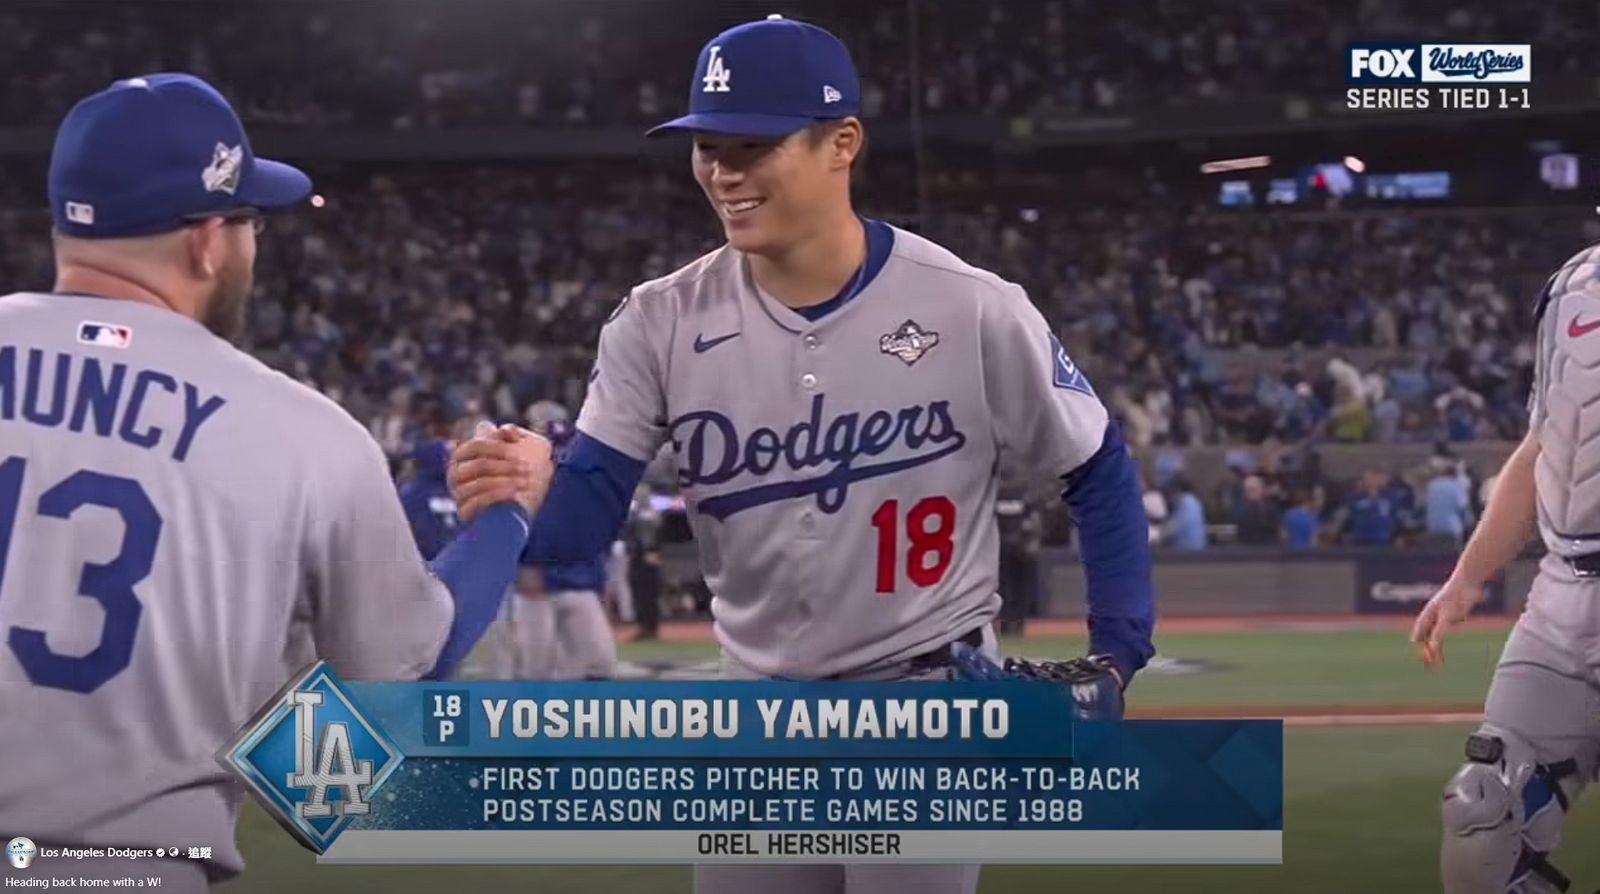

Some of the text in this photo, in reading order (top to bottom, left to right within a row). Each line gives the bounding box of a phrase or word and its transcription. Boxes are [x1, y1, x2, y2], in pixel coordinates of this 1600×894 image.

[703, 46, 731, 92] LA
[0, 345, 226, 463] UNCY
[668, 393, 966, 522] Dodgers
[0, 455, 163, 694] 3
[871, 496, 957, 593] 18
